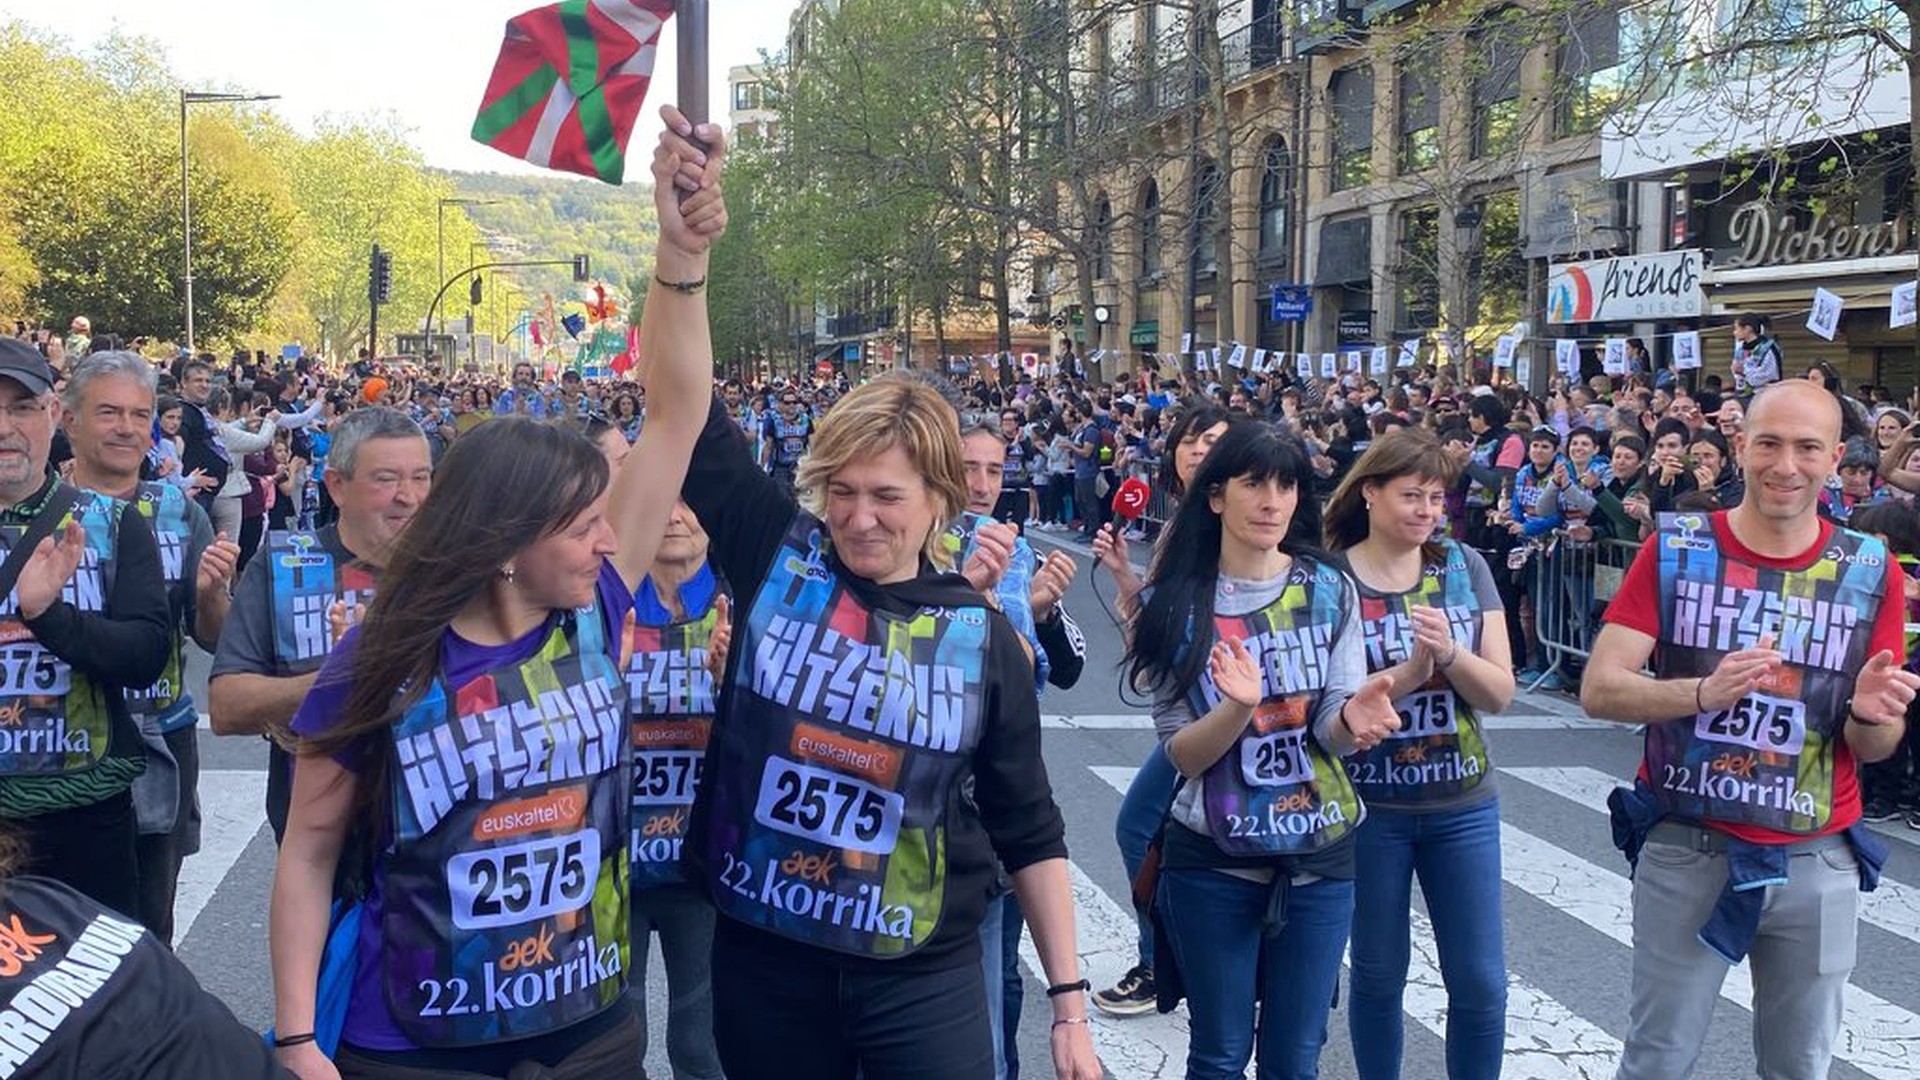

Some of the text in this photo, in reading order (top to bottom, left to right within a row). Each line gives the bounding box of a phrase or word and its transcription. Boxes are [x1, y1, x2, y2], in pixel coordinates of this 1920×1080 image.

[1727, 200, 1902, 267] Dickens
[1636, 301, 1694, 315] DISCO
[1400, 694, 1449, 732] 75
[1708, 698, 1792, 746] 2575
[799, 735, 872, 770] euskaltel
[1711, 751, 1759, 778] aek
[481, 802, 560, 833] euskaltel
[770, 770, 886, 843] 2575
[1273, 787, 1313, 813] aek
[643, 808, 685, 836] aek
[468, 840, 587, 918] 2575
[782, 850, 838, 886] aek
[499, 921, 556, 972] aek
